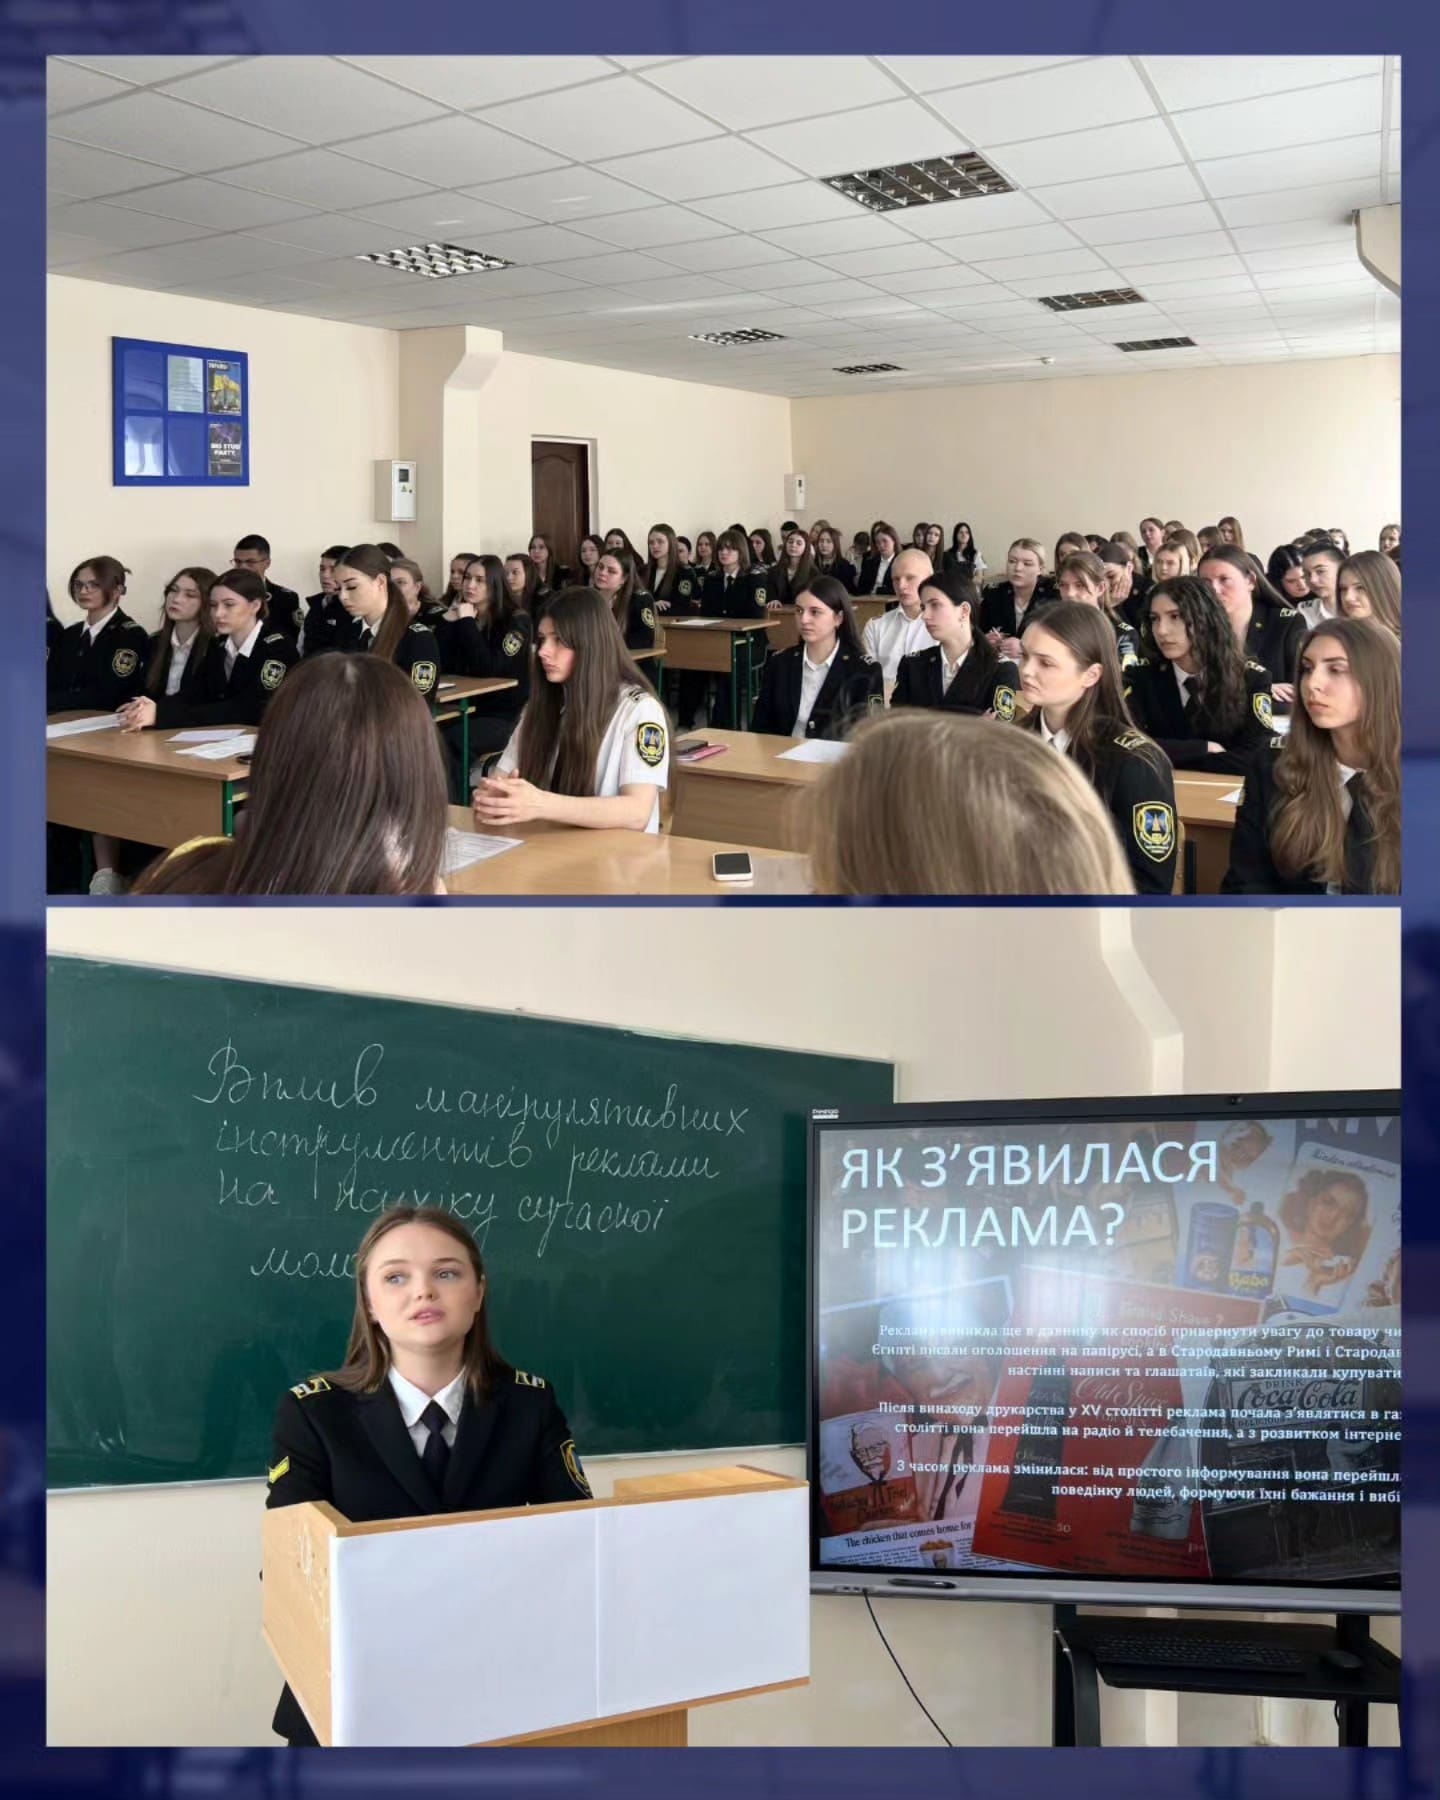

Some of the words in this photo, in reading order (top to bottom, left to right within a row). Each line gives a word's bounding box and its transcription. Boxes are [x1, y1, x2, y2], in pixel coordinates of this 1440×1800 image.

[193, 1037, 384, 1109] Вплив
[567, 1144, 720, 1204] реклами
[840, 1146, 904, 1190] ЯК
[920, 1139, 1219, 1189] З’ЯВИЛАСЯ
[219, 1168, 280, 1206] на
[518, 1196, 670, 1258] сучасної
[841, 1202, 1127, 1250] РЕКЛАМА?
[880, 1325, 937, 1338] Реклама
[1003, 1328, 1021, 1339] ще
[1101, 1328, 1119, 1338] як
[1122, 1325, 1167, 1338] спосіб
[1171, 1327, 1257, 1340] привернути
[1262, 1327, 1301, 1340] увагу
[1306, 1327, 1324, 1340] до
[1328, 1327, 1379, 1340] товару
[871, 1343, 915, 1356] Єгипті
[971, 1346, 1056, 1357] оголошення
[1061, 1347, 1077, 1357] на
[1082, 1345, 1142, 1360] папірусі,
[1146, 1347, 1154, 1357] а
[1159, 1347, 1167, 1358] в
[1170, 1345, 1284, 1360] Стародавньому
[1287, 1346, 1321, 1358] Римі
[1008, 1364, 1066, 1377] настінні
[1070, 1366, 1121, 1377] написи
[1125, 1367, 1140, 1378] та
[1145, 1365, 1219, 1379] глашатаїв,
[1224, 1366, 1245, 1378] які
[1250, 1367, 1328, 1379] закликали
[1332, 1367, 1402, 1382] купувати
[1265, 1380, 1306, 1390] DRINK
[879, 1402, 915, 1414] Після
[919, 1404, 982, 1418] винаходу
[986, 1405, 1065, 1418] друкарства
[1068, 1406, 1078, 1418] у
[1081, 1404, 1101, 1416] XV
[1105, 1405, 1162, 1418] столітті
[1167, 1407, 1226, 1421] реклама
[1231, 1408, 1281, 1420] почала
[1370, 1409, 1379, 1420] в
[895, 1422, 948, 1434] столітті
[953, 1425, 985, 1435] вона
[989, 1423, 1058, 1437] перейшла
[1062, 1426, 1079, 1437] на
[1083, 1424, 1121, 1439] радіо
[1125, 1424, 1134, 1437] й
[1138, 1426, 1233, 1440] телебачення,
[1236, 1429, 1244, 1439] а
[1248, 1429, 1256, 1439] з
[1260, 1428, 1340, 1442] розвитком
[896, 1460, 905, 1472] З
[909, 1462, 949, 1473] часом
[952, 1463, 1011, 1476] реклама
[1014, 1463, 1089, 1476] змінилася:
[1092, 1464, 1114, 1478] від
[1118, 1467, 1182, 1479] простого
[1186, 1466, 1290, 1482] інформування
[1294, 1470, 1329, 1482] вона
[1333, 1469, 1402, 1485] перейшл
[1051, 1483, 1122, 1498] поведінку
[1127, 1484, 1175, 1499] людей,
[1179, 1485, 1256, 1502] формуючи
[1259, 1487, 1286, 1501] їхні
[1291, 1488, 1355, 1502] бажання
[845, 1537, 861, 1548] The
[862, 1533, 892, 1545] chicken
[892, 1530, 908, 1541] that
[909, 1527, 936, 1539] comes
[936, 1523, 960, 1536] home
[960, 1519, 972, 1531] for
